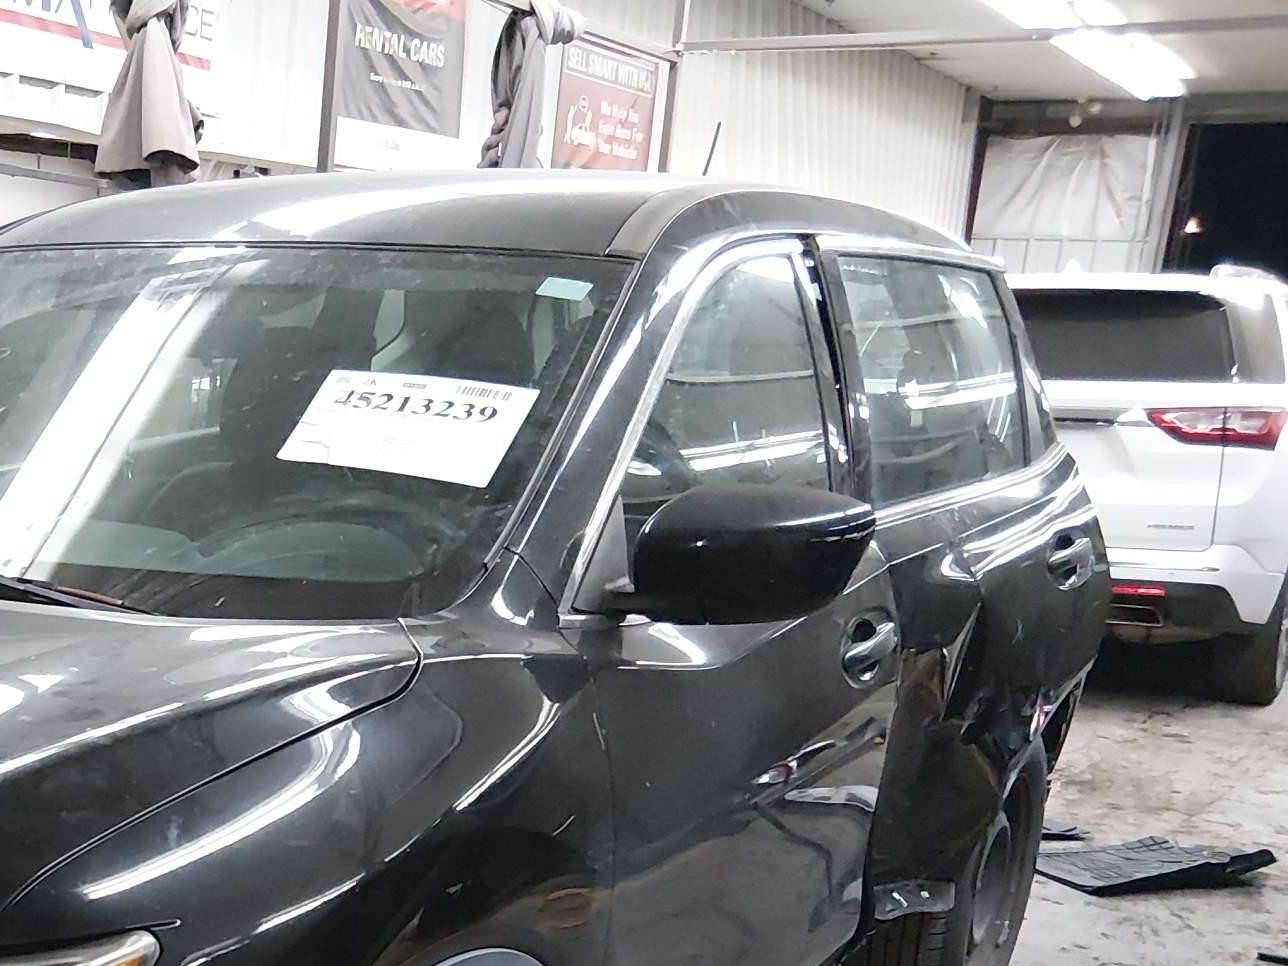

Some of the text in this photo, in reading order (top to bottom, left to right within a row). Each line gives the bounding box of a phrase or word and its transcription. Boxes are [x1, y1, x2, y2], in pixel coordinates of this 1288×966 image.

[354, 22, 445, 68] RENTAL CARS
[567, 46, 588, 73] SELL
[587, 53, 618, 82] SMART
[333, 389, 498, 423] 45213239
